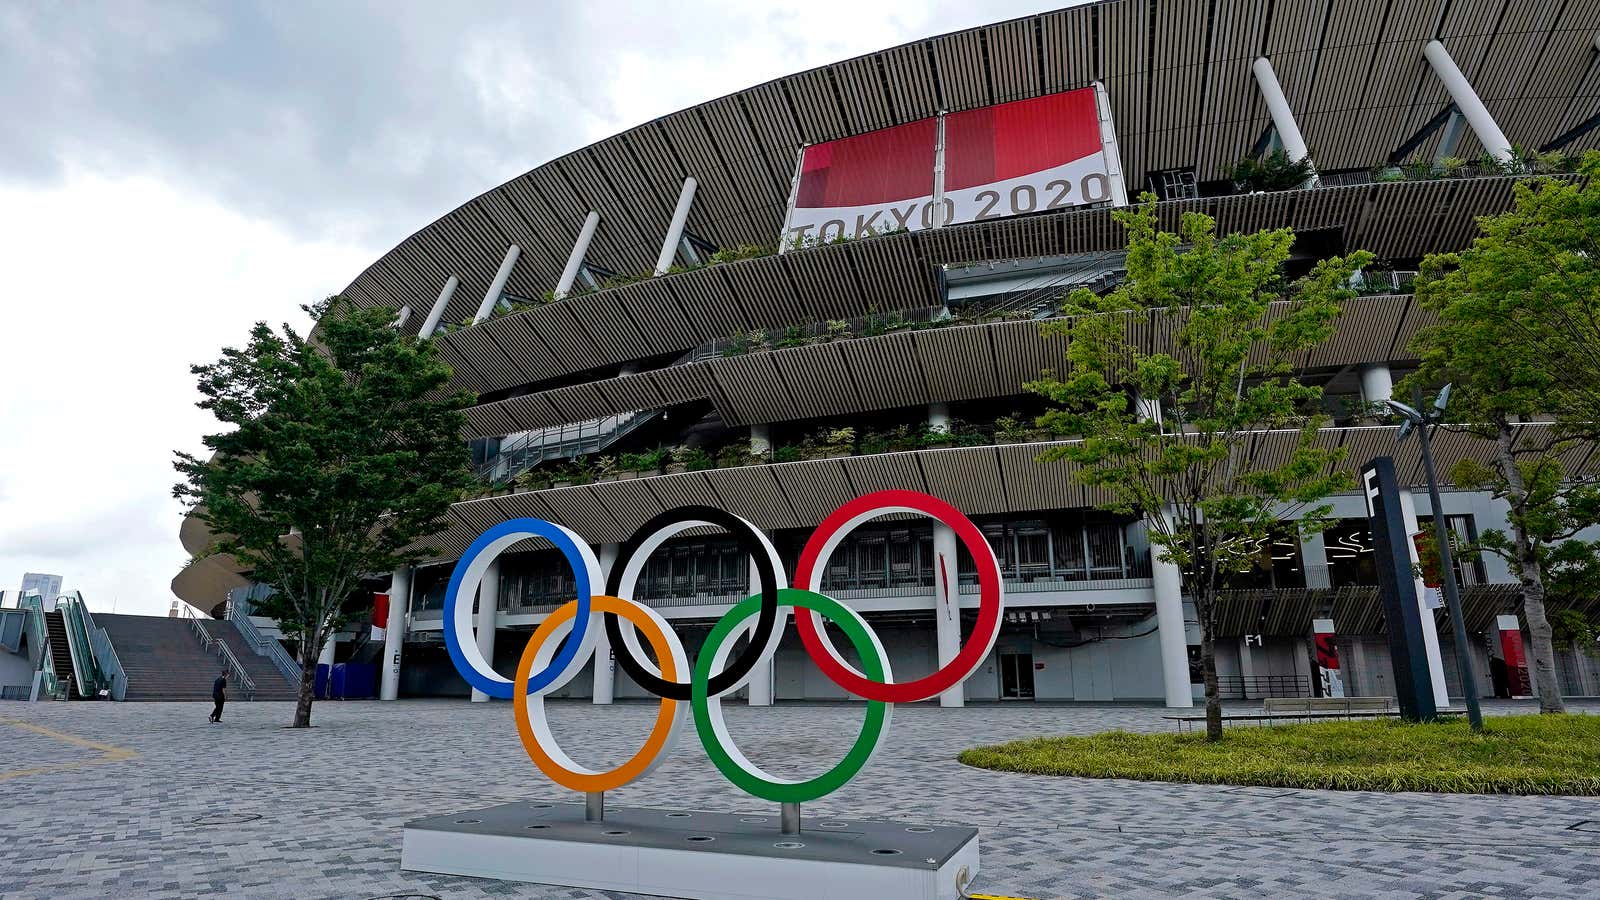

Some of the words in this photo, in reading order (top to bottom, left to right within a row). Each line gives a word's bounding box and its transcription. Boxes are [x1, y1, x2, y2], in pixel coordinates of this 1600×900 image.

[789, 196, 954, 247] TOKYO
[974, 172, 1110, 221] 2020
[1363, 467, 1379, 518] F
[1245, 634, 1262, 647] F1
[393, 654, 401, 665] E
